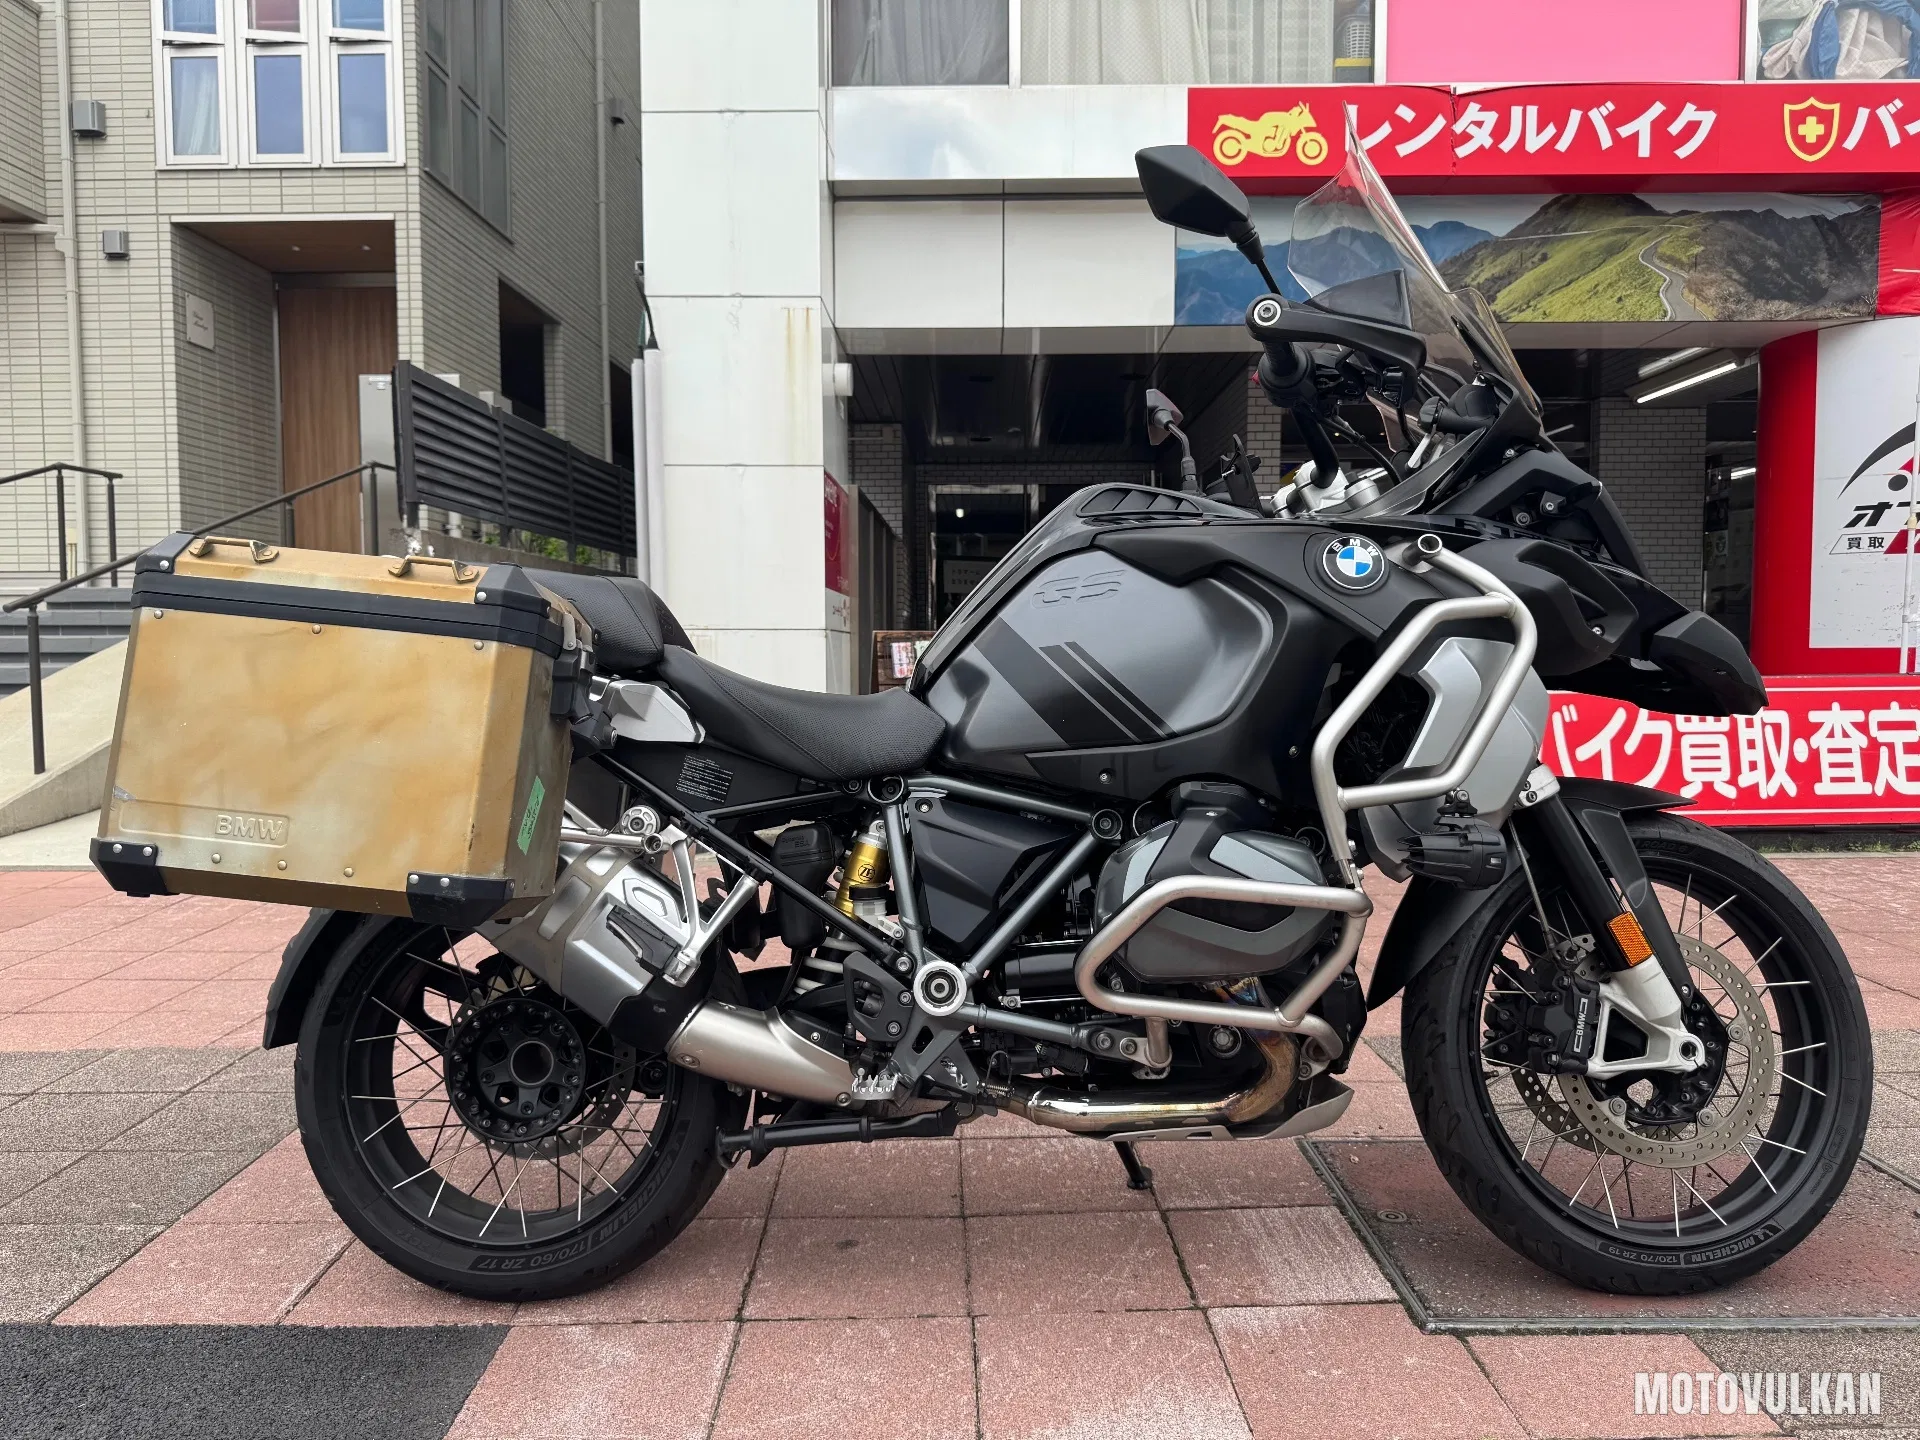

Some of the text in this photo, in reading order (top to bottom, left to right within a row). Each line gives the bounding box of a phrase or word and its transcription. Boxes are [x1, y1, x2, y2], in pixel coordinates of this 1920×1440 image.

[1345, 100, 1717, 159] レンタルバイク
[1332, 538, 1378, 557] BMW
[1847, 536, 1884, 550] 買取
[1031, 569, 1127, 609] GS
[215, 814, 283, 841] BMW
[1641, 840, 1676, 850] ROAD
[1575, 1012, 1587, 1036] BMW
[600, 1154, 673, 1240] MICHELIN
[477, 1240, 585, 1269] 170/60 ZR 17
[1609, 1246, 1678, 1264] 120/70 ZR 19
[1691, 1237, 1756, 1263] MICHELIN
